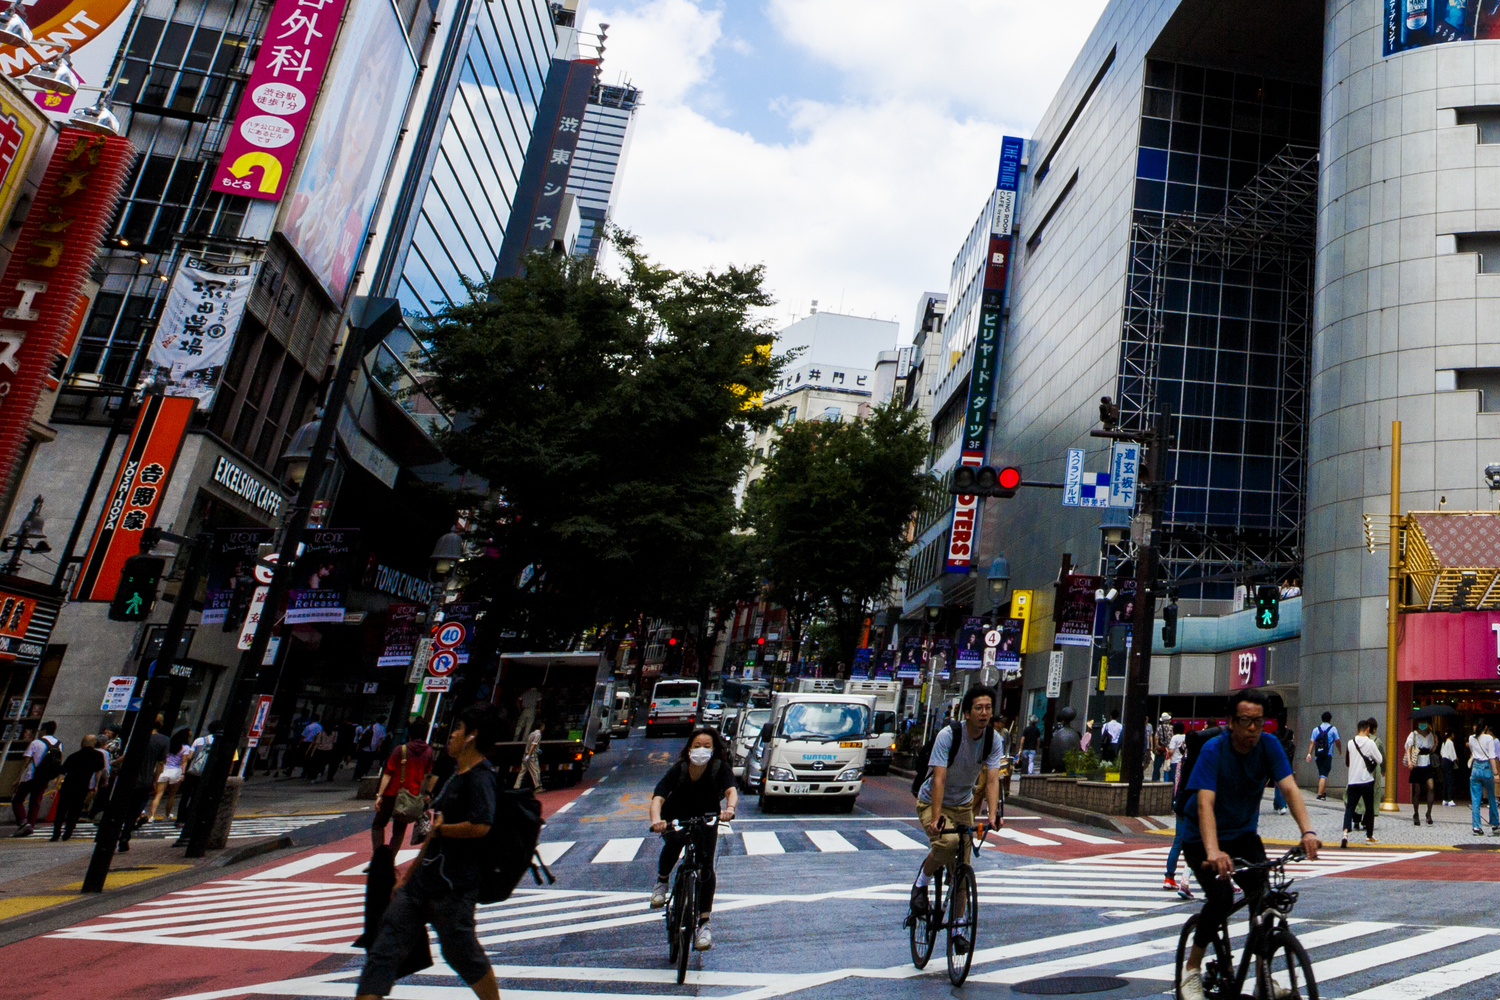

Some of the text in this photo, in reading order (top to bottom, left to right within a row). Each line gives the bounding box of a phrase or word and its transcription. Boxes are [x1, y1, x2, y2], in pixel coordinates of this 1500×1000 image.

[256, 95, 298, 111] 徒歩1分
[263, 87, 298, 102] 渋谷駅
[1000, 144, 1019, 188] THE PRIME
[222, 177, 252, 190] もどる
[529, 116, 580, 254] 渋東シネ
[214, 455, 284, 517] EXCELSIOR CAFFE
[1066, 450, 1081, 504] スクランブル式
[1120, 448, 1137, 503] 道玄坂下
[104, 461, 138, 531] YOSHINOYA
[121, 462, 165, 532] 吉野家
[374, 563, 399, 595] TOHO
[294, 600, 340, 608] Release
[442, 629, 459, 641] 40
[987, 632, 996, 644] 4
[1060, 627, 1089, 635] Release
[1238, 652, 1251, 684] 109
[801, 753, 838, 761] SUNTORY
